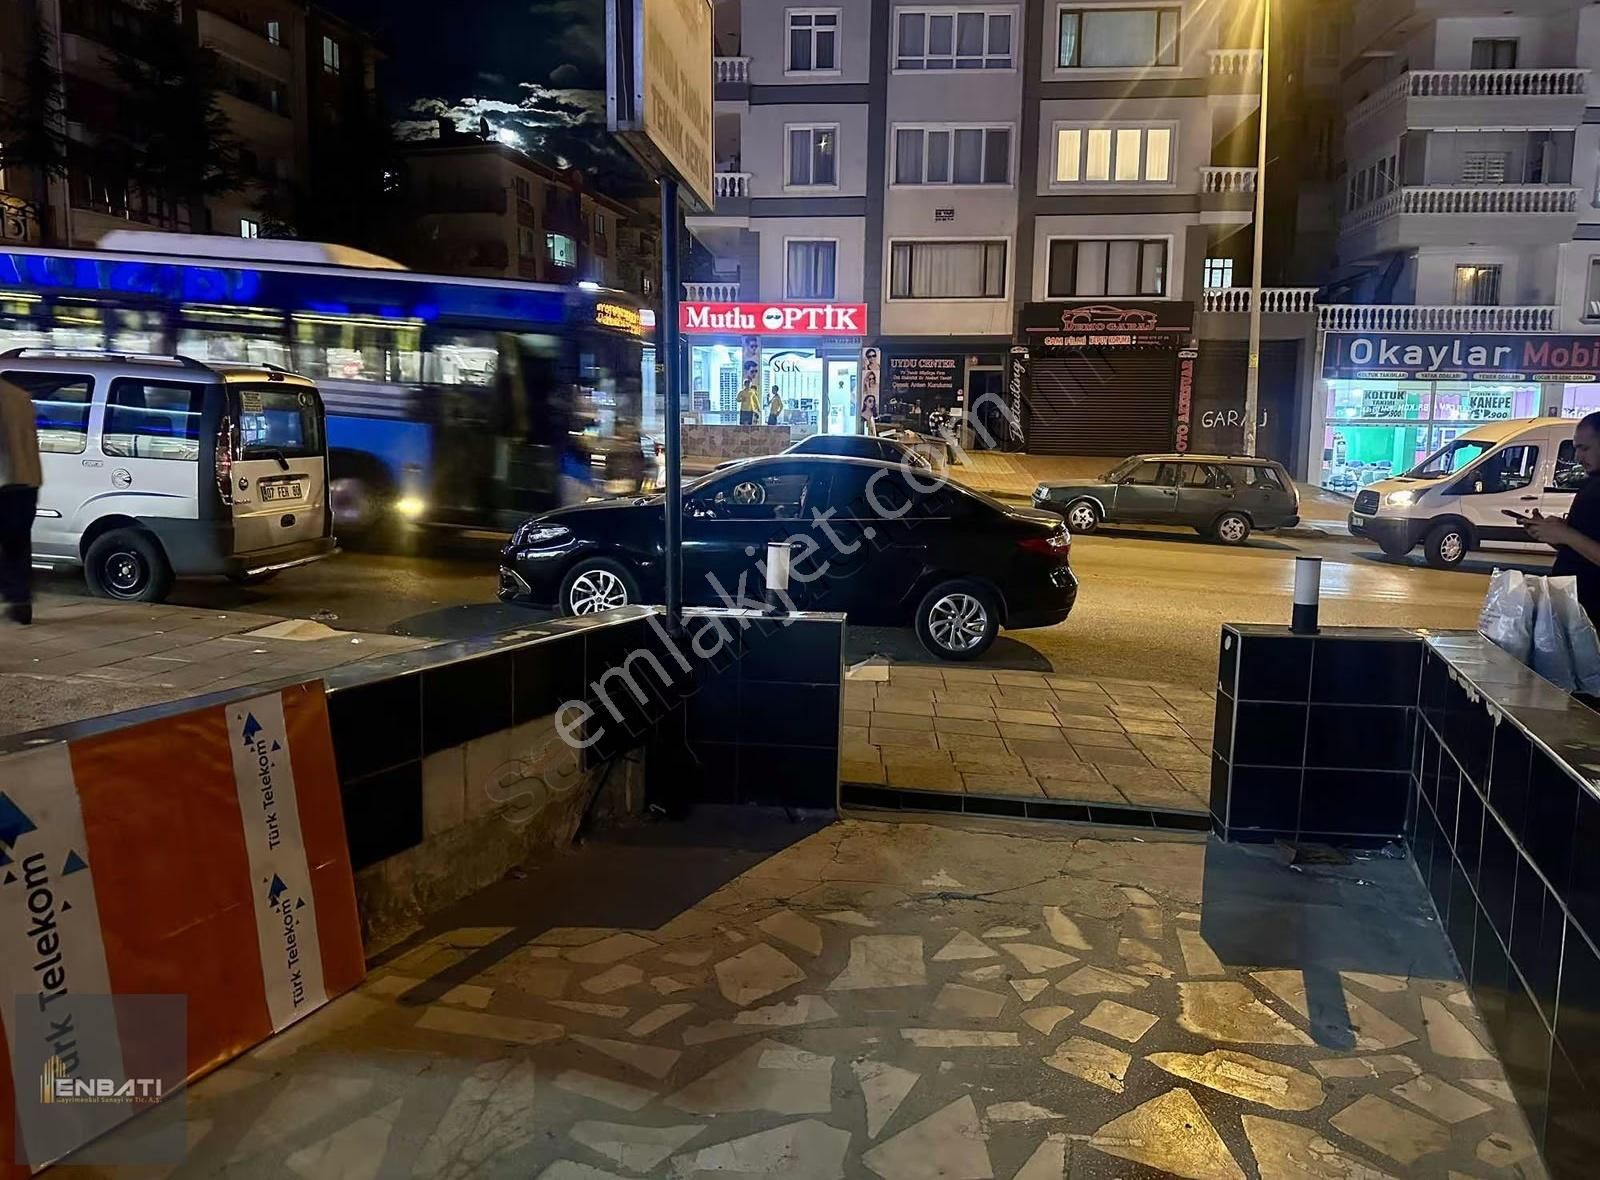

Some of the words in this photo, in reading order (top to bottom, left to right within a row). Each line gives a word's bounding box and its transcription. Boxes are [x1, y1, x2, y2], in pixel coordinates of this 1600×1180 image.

[686, 306, 755, 329] Mutlu
[762, 304, 858, 330] OPTİK
[773, 360, 800, 373] SGK
[890, 359, 917, 368] UYDU
[918, 359, 956, 368] CENTER
[1350, 338, 1512, 371] Okaylar
[1009, 358, 1027, 444] Detailing
[1365, 391, 1405, 400] KOLTUK
[1470, 397, 1511, 408] KANEPE
[1175, 424, 1189, 452] OTO
[257, 739, 275, 810] Telekom
[263, 814, 281, 850] Türk
[22, 852, 68, 1012] Telekom
[282, 898, 299, 968] Telekom
[287, 970, 305, 1008] Türk
